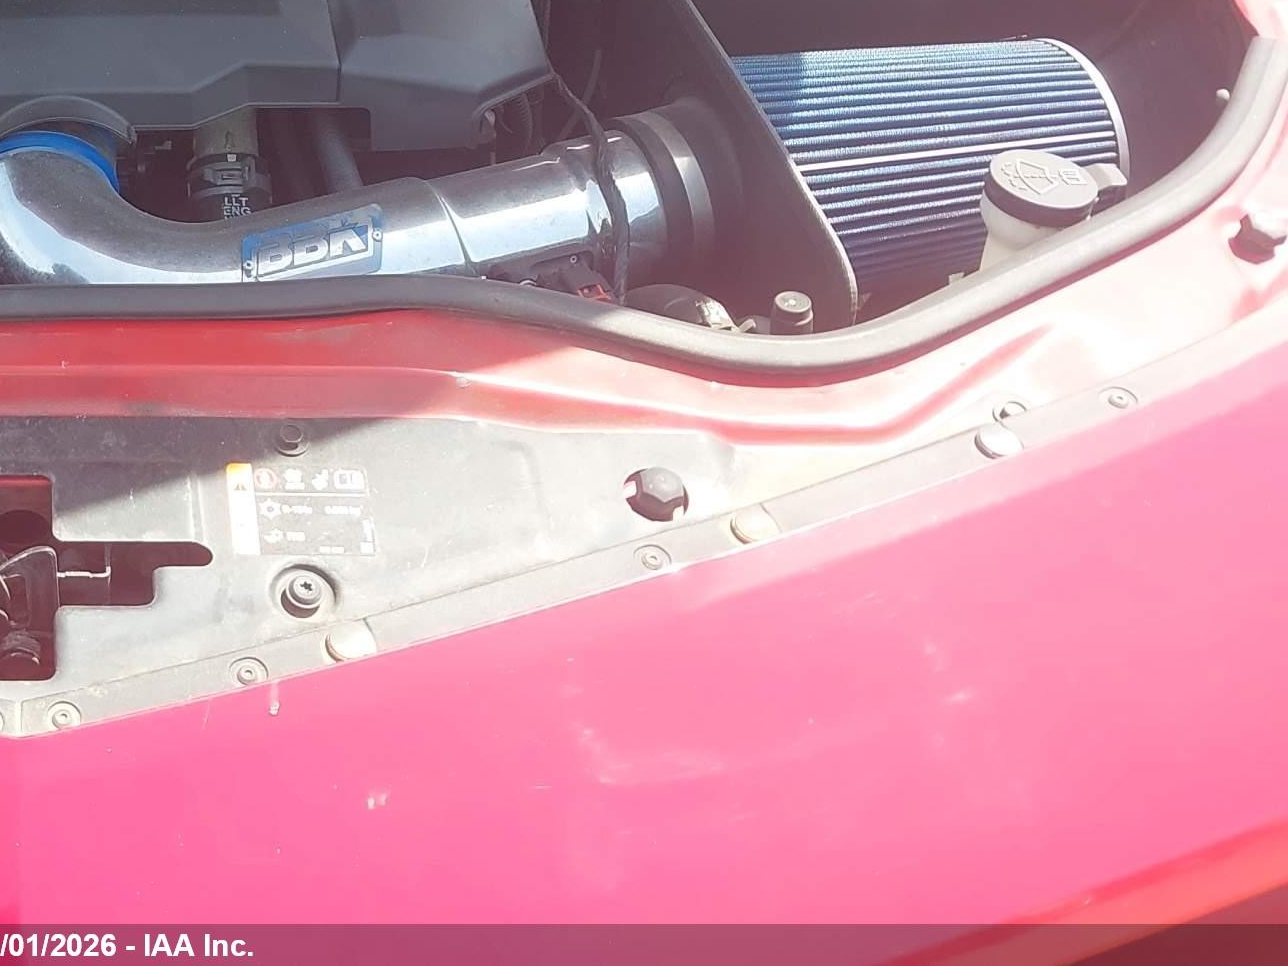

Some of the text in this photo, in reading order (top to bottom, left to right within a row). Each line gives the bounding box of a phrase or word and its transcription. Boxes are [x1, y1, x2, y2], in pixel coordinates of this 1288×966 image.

[224, 197, 249, 207] LLT
[223, 206, 252, 216] ENG
[257, 224, 369, 276] BBK
